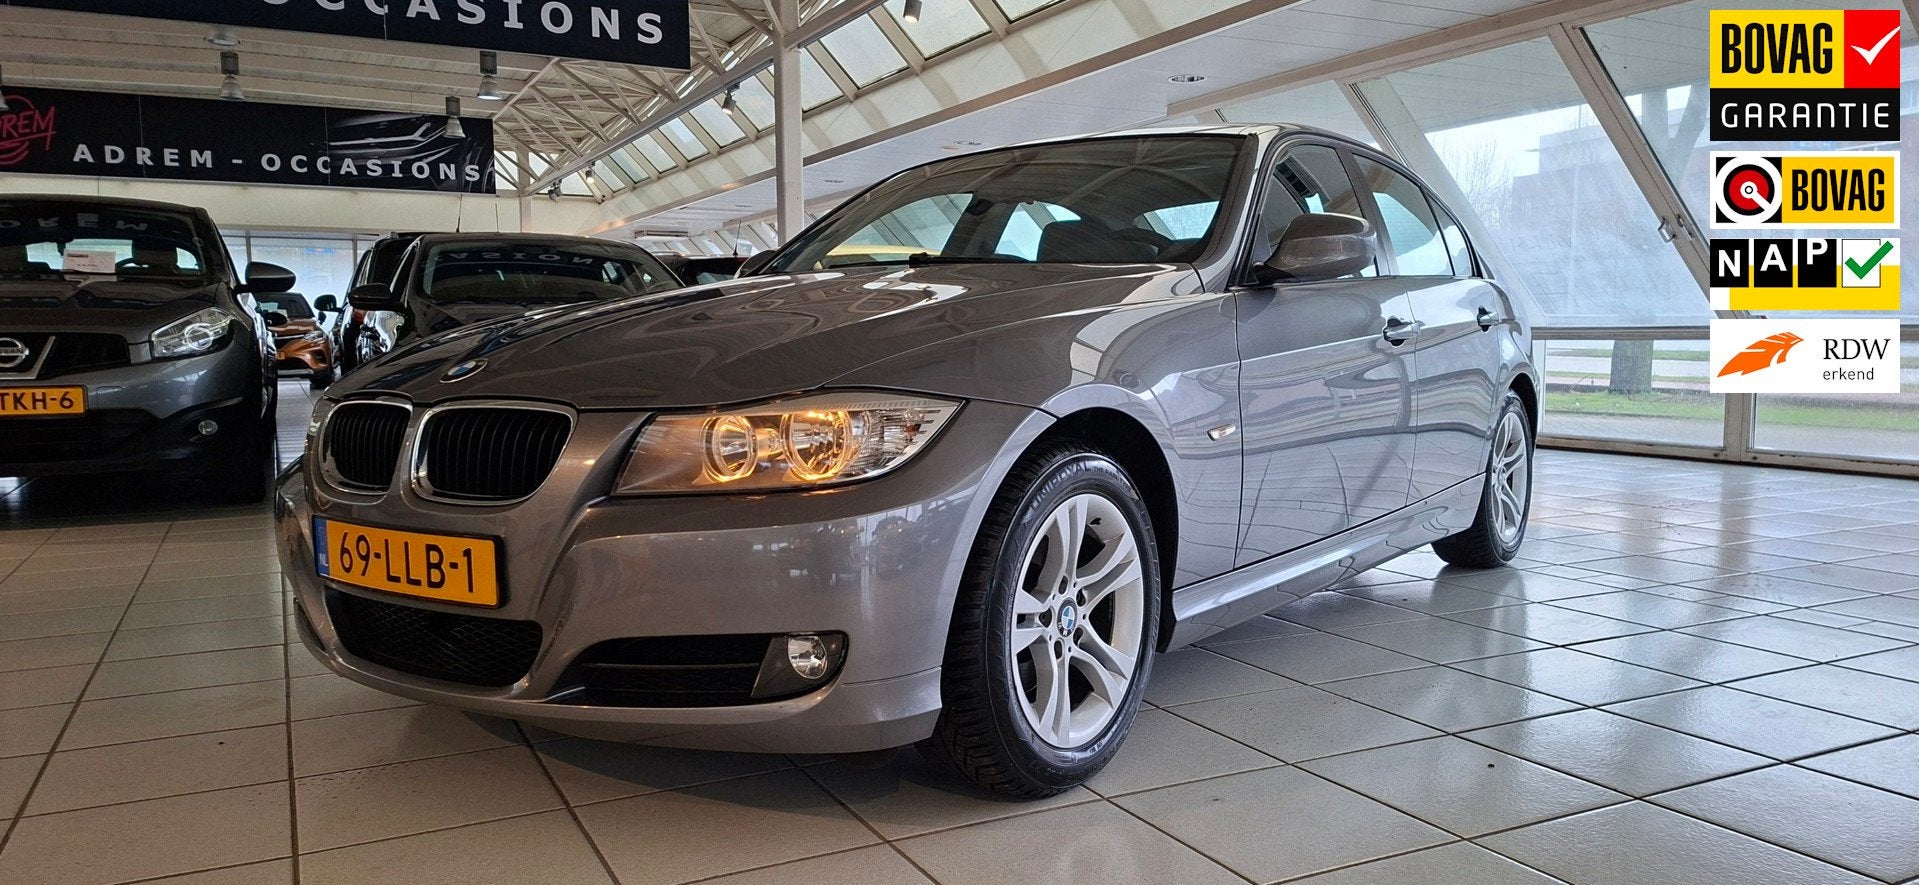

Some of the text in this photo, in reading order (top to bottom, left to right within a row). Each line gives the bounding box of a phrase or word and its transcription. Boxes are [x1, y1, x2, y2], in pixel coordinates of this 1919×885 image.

[262, 0, 662, 44] ASIONS
[0, 106, 56, 151] REM
[72, 143, 213, 168] ADREM
[260, 153, 481, 182] OCCASIONS
[339, 531, 475, 594] 69-LLB-1
